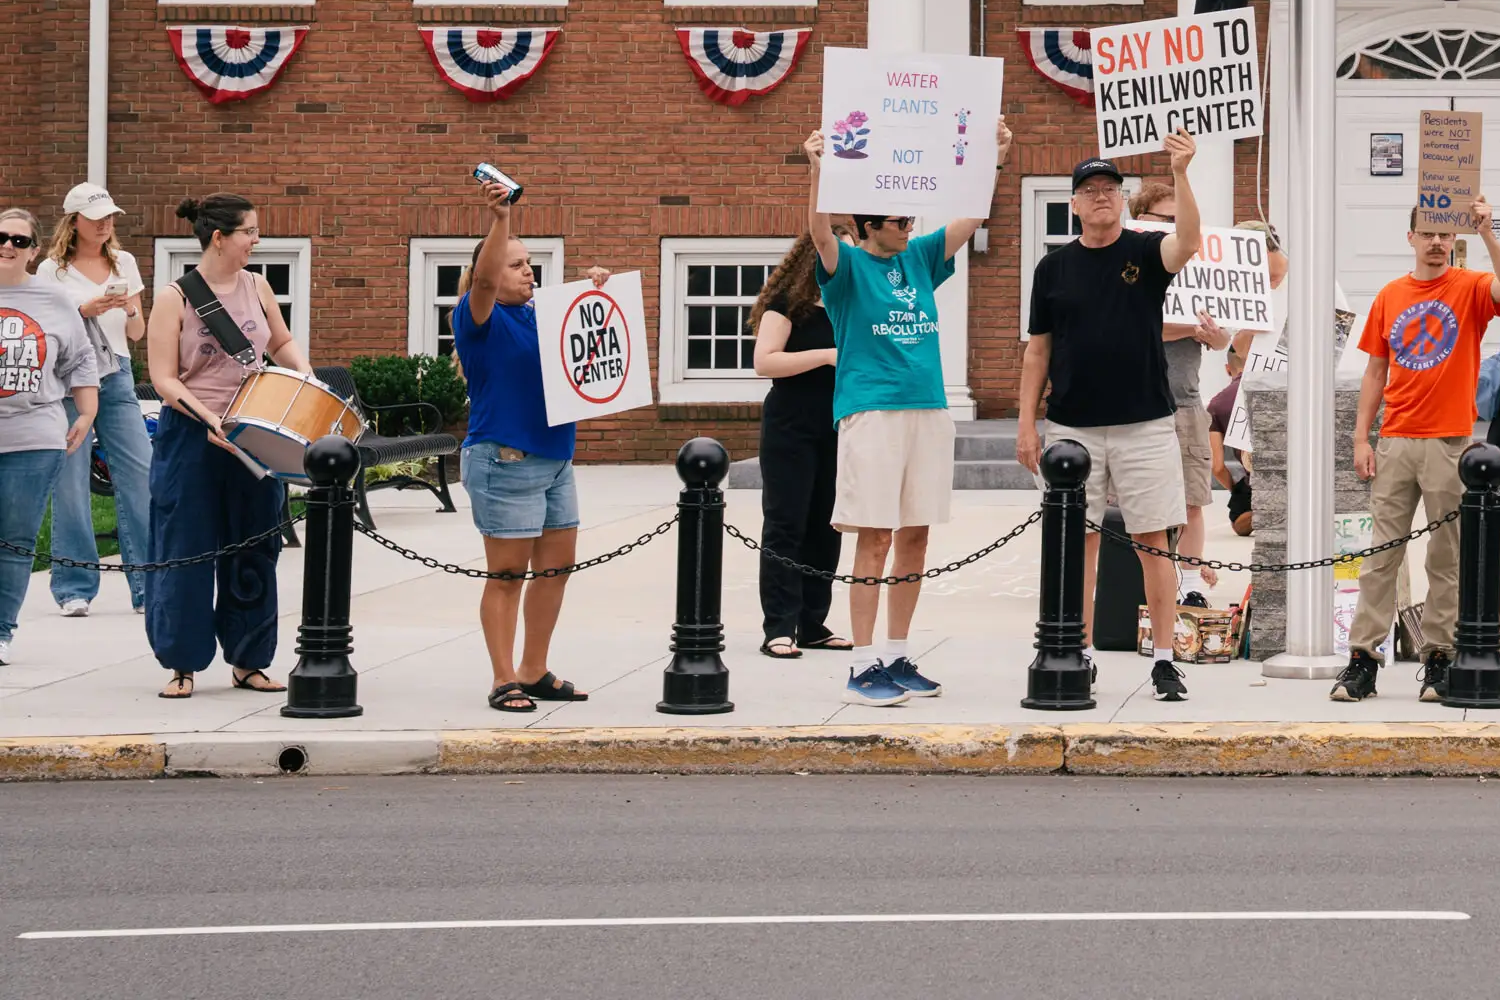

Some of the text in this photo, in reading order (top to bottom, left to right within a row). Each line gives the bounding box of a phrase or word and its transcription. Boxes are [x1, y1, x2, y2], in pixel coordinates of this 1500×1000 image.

[1096, 18, 1250, 75] SAY NO TO
[887, 71, 938, 89] WATER
[1100, 61, 1253, 113] KENILWORTH
[882, 97, 938, 115] PLANTS
[1103, 98, 1257, 149] DATA CENTER
[1423, 112, 1468, 127] Residents
[1424, 129, 1471, 139] were NOT
[1423, 142, 1459, 151] informed
[892, 149, 924, 165] NOT
[1422, 151, 1454, 162] because
[875, 174, 937, 191] SERVERS
[1419, 193, 1452, 209] NO
[1231, 236, 1262, 266] TO
[579, 301, 605, 329] NO
[919, 310, 929, 322] A
[1191, 294, 1269, 323] CENTER
[570, 326, 622, 363] DATA
[573, 357, 625, 386] CENTER
